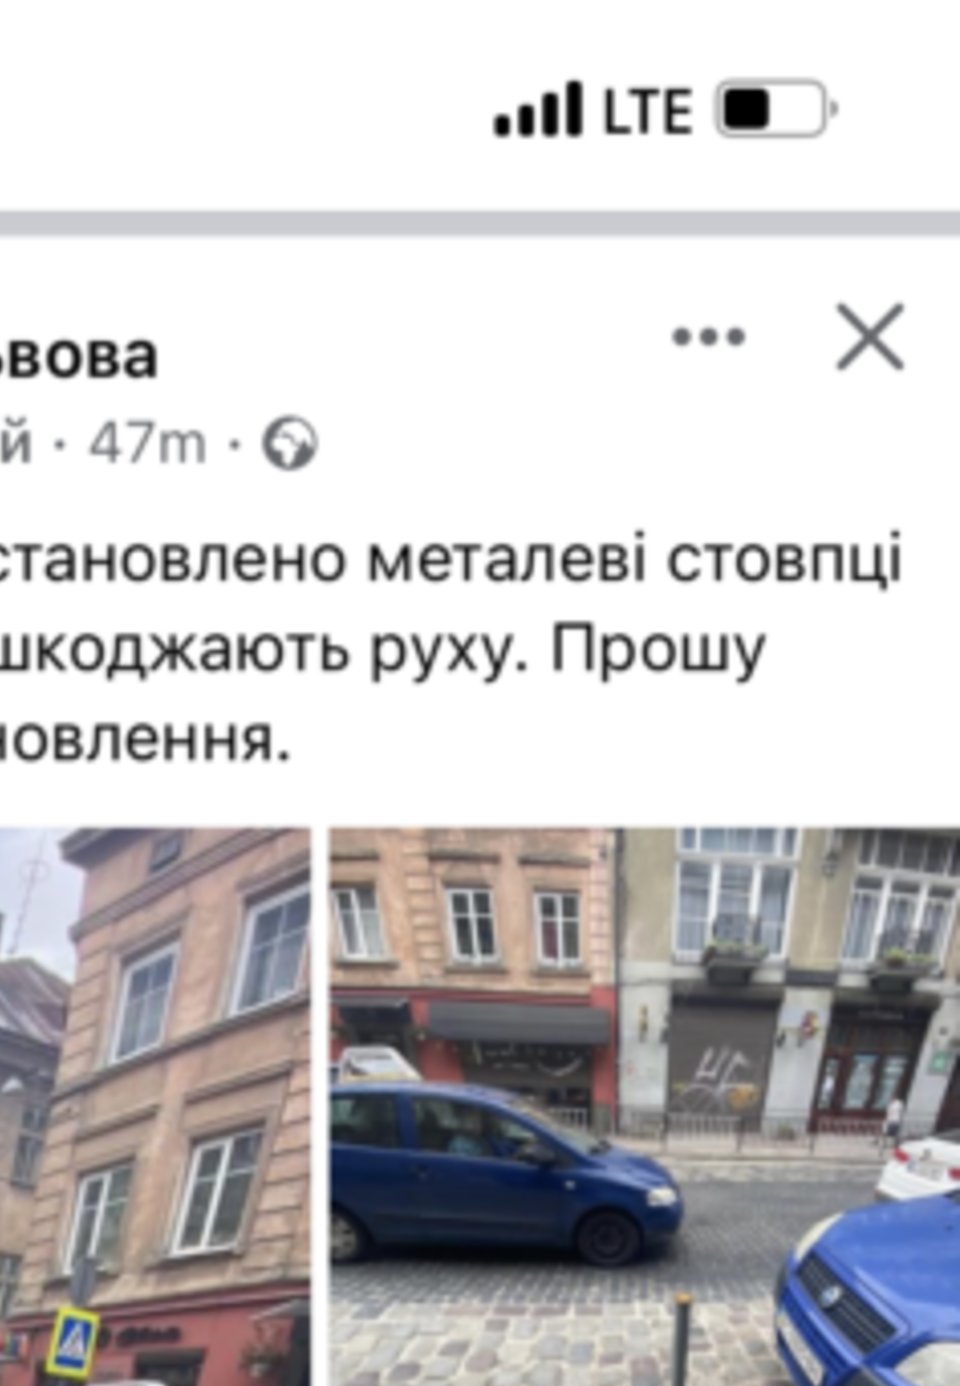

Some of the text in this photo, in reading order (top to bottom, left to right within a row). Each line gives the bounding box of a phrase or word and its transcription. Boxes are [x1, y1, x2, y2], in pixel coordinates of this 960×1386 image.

[604, 87, 693, 136] LTE
[89, 420, 206, 463] 47m
[368, 529, 645, 583] металеві
[667, 529, 901, 592] стовпці
[371, 632, 528, 685] руху.
[552, 620, 767, 685] Прошу
